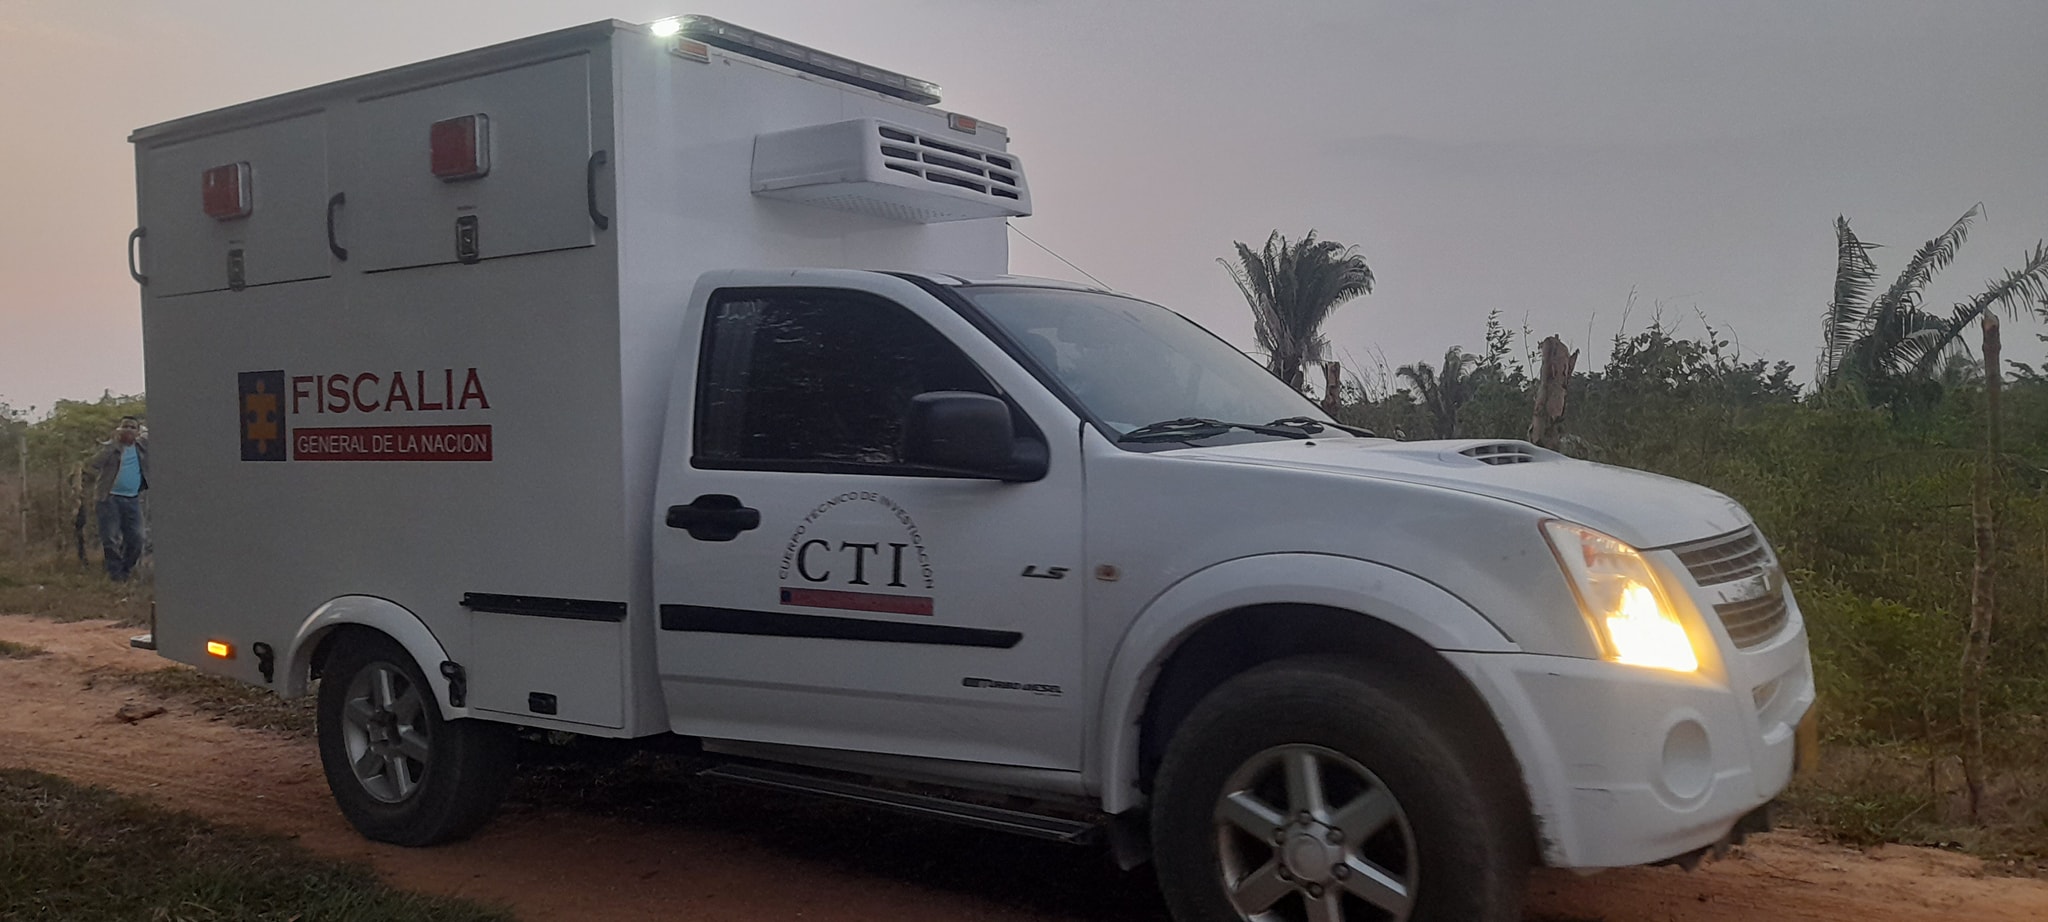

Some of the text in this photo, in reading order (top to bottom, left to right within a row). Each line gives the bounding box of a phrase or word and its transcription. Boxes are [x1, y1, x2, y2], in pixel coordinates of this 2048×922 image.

[291, 367, 491, 414] FISCALIA
[297, 433, 487, 454] GENERAL DE LA NACION
[779, 525, 806, 580] CUERPO
[804, 491, 858, 524] TECNICO
[860, 491, 879, 502] DE
[797, 539, 909, 588] CTI
[1021, 565, 1071, 580] LS
